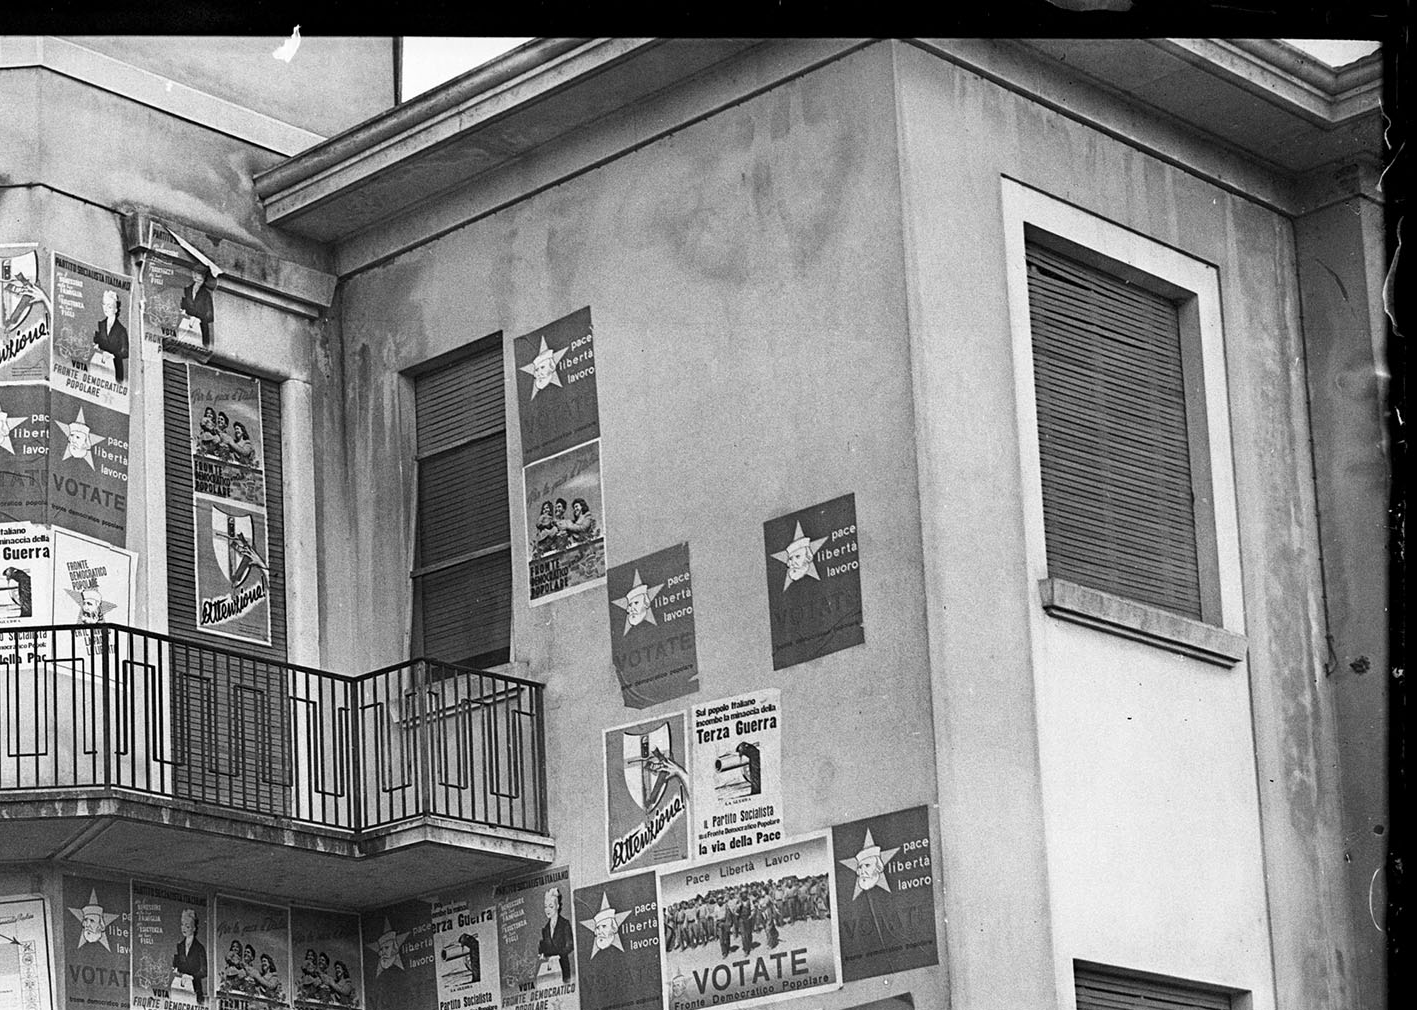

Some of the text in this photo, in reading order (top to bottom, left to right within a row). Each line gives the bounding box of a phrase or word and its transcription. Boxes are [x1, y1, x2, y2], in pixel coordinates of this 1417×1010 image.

[571, 334, 592, 351] pace
[559, 349, 594, 370] libertà
[54, 363, 128, 395] FRONTE DEMOCRATICO
[568, 366, 594, 385] lavoro
[66, 379, 100, 397] POPOLARE
[108, 436, 128, 450] pace
[94, 446, 129, 466] libertà
[101, 466, 128, 481] lavoro
[55, 474, 125, 511] VOTATE
[832, 525, 855, 541] pace
[3, 547, 50, 560] Guerra
[818, 541, 858, 563] libertà
[827, 560, 858, 577] lavoro
[696, 699, 755, 717] Sul popolo Italiano
[696, 704, 776, 727] incombe la minaccia della
[696, 717, 776, 743] Terza Guerra
[713, 805, 774, 827] Partito Socialista
[725, 822, 756, 834] Democratico
[758, 818, 780, 828] Popolare
[699, 831, 780, 855] la via della Pace
[686, 851, 800, 886] Pace Libertà Lavoro
[693, 949, 808, 994] VOTATE
[675, 974, 829, 1010] Fronte Democratico Popolare
